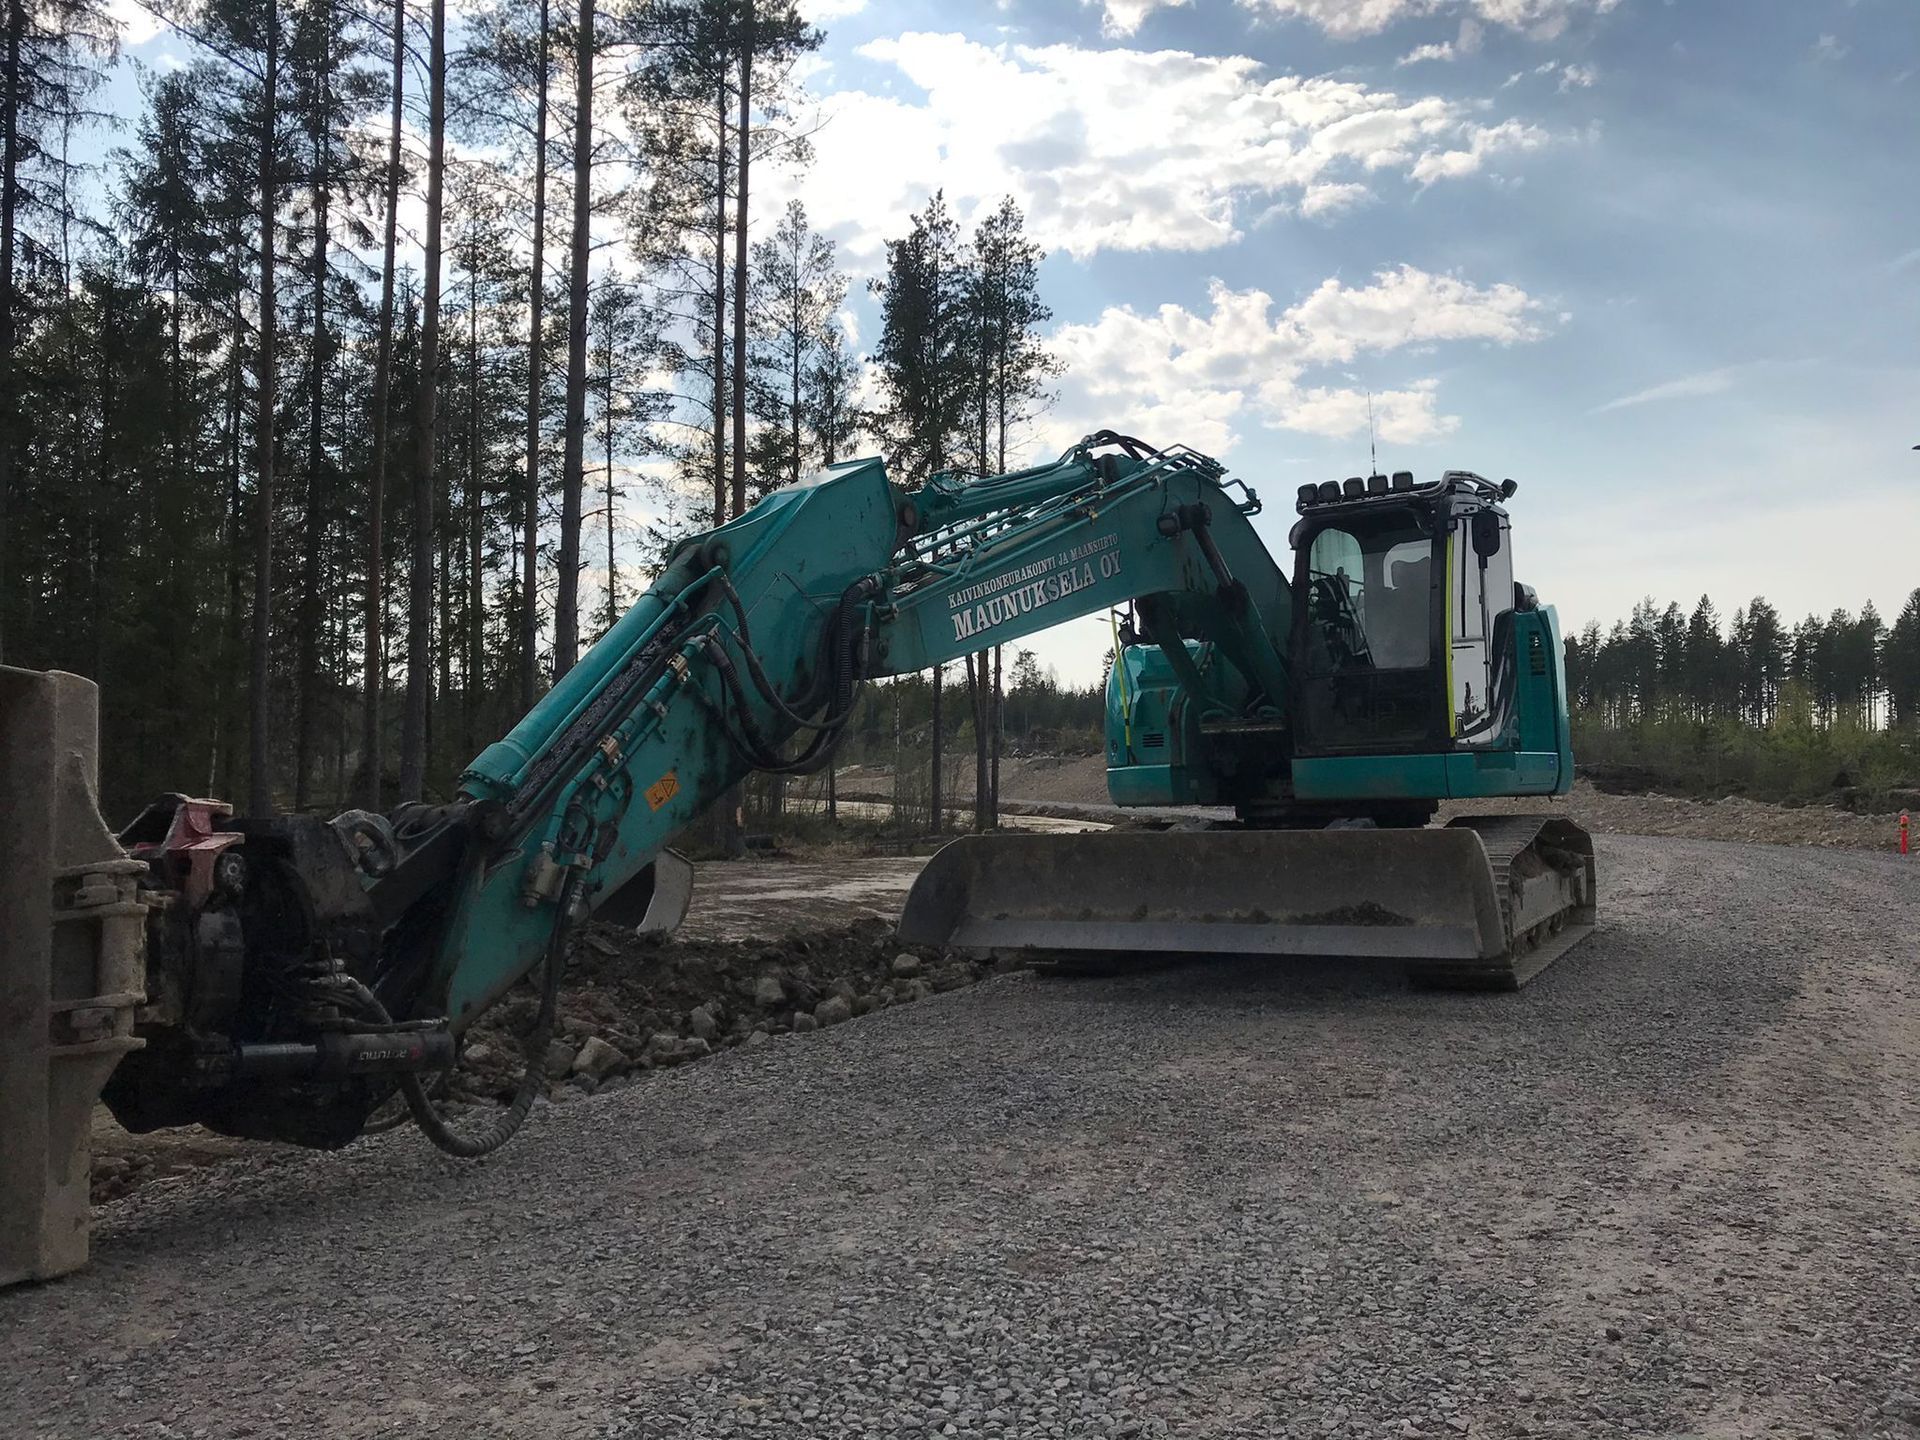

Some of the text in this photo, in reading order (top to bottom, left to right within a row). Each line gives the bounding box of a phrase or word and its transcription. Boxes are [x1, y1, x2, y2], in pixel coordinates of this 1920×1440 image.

[948, 556, 1056, 608] KAIVINKONEURAKOINTI
[1058, 551, 1069, 566] JA
[951, 549, 1121, 642] MAUNUKSELA OY
